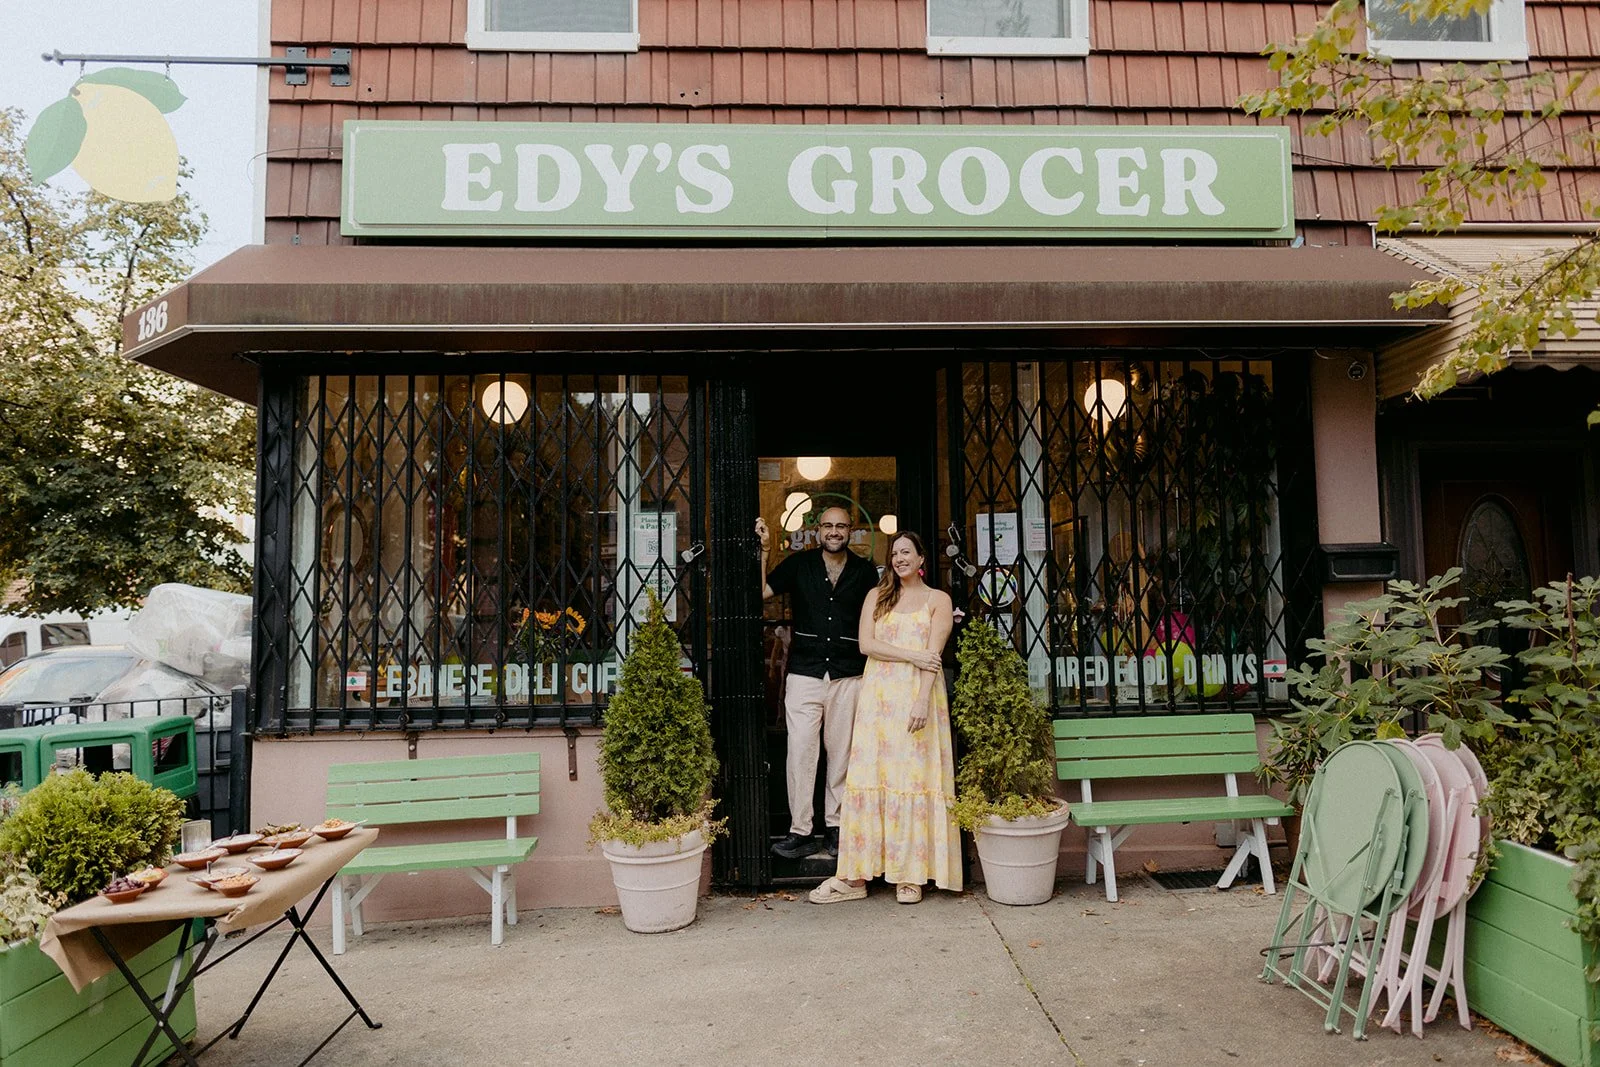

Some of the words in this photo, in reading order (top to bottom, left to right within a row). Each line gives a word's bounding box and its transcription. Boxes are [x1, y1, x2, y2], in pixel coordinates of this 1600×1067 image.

[441, 142, 734, 214] EDY'S
[787, 146, 1226, 217] GROCER
[137, 300, 168, 342] 136
[646, 523, 671, 531] Pary?
[505, 662, 558, 696] DELI
[571, 661, 617, 695] COF
[1028, 655, 1109, 688] EPARED
[1113, 655, 1168, 686] FOOD
[1183, 653, 1258, 686] DRINKS
